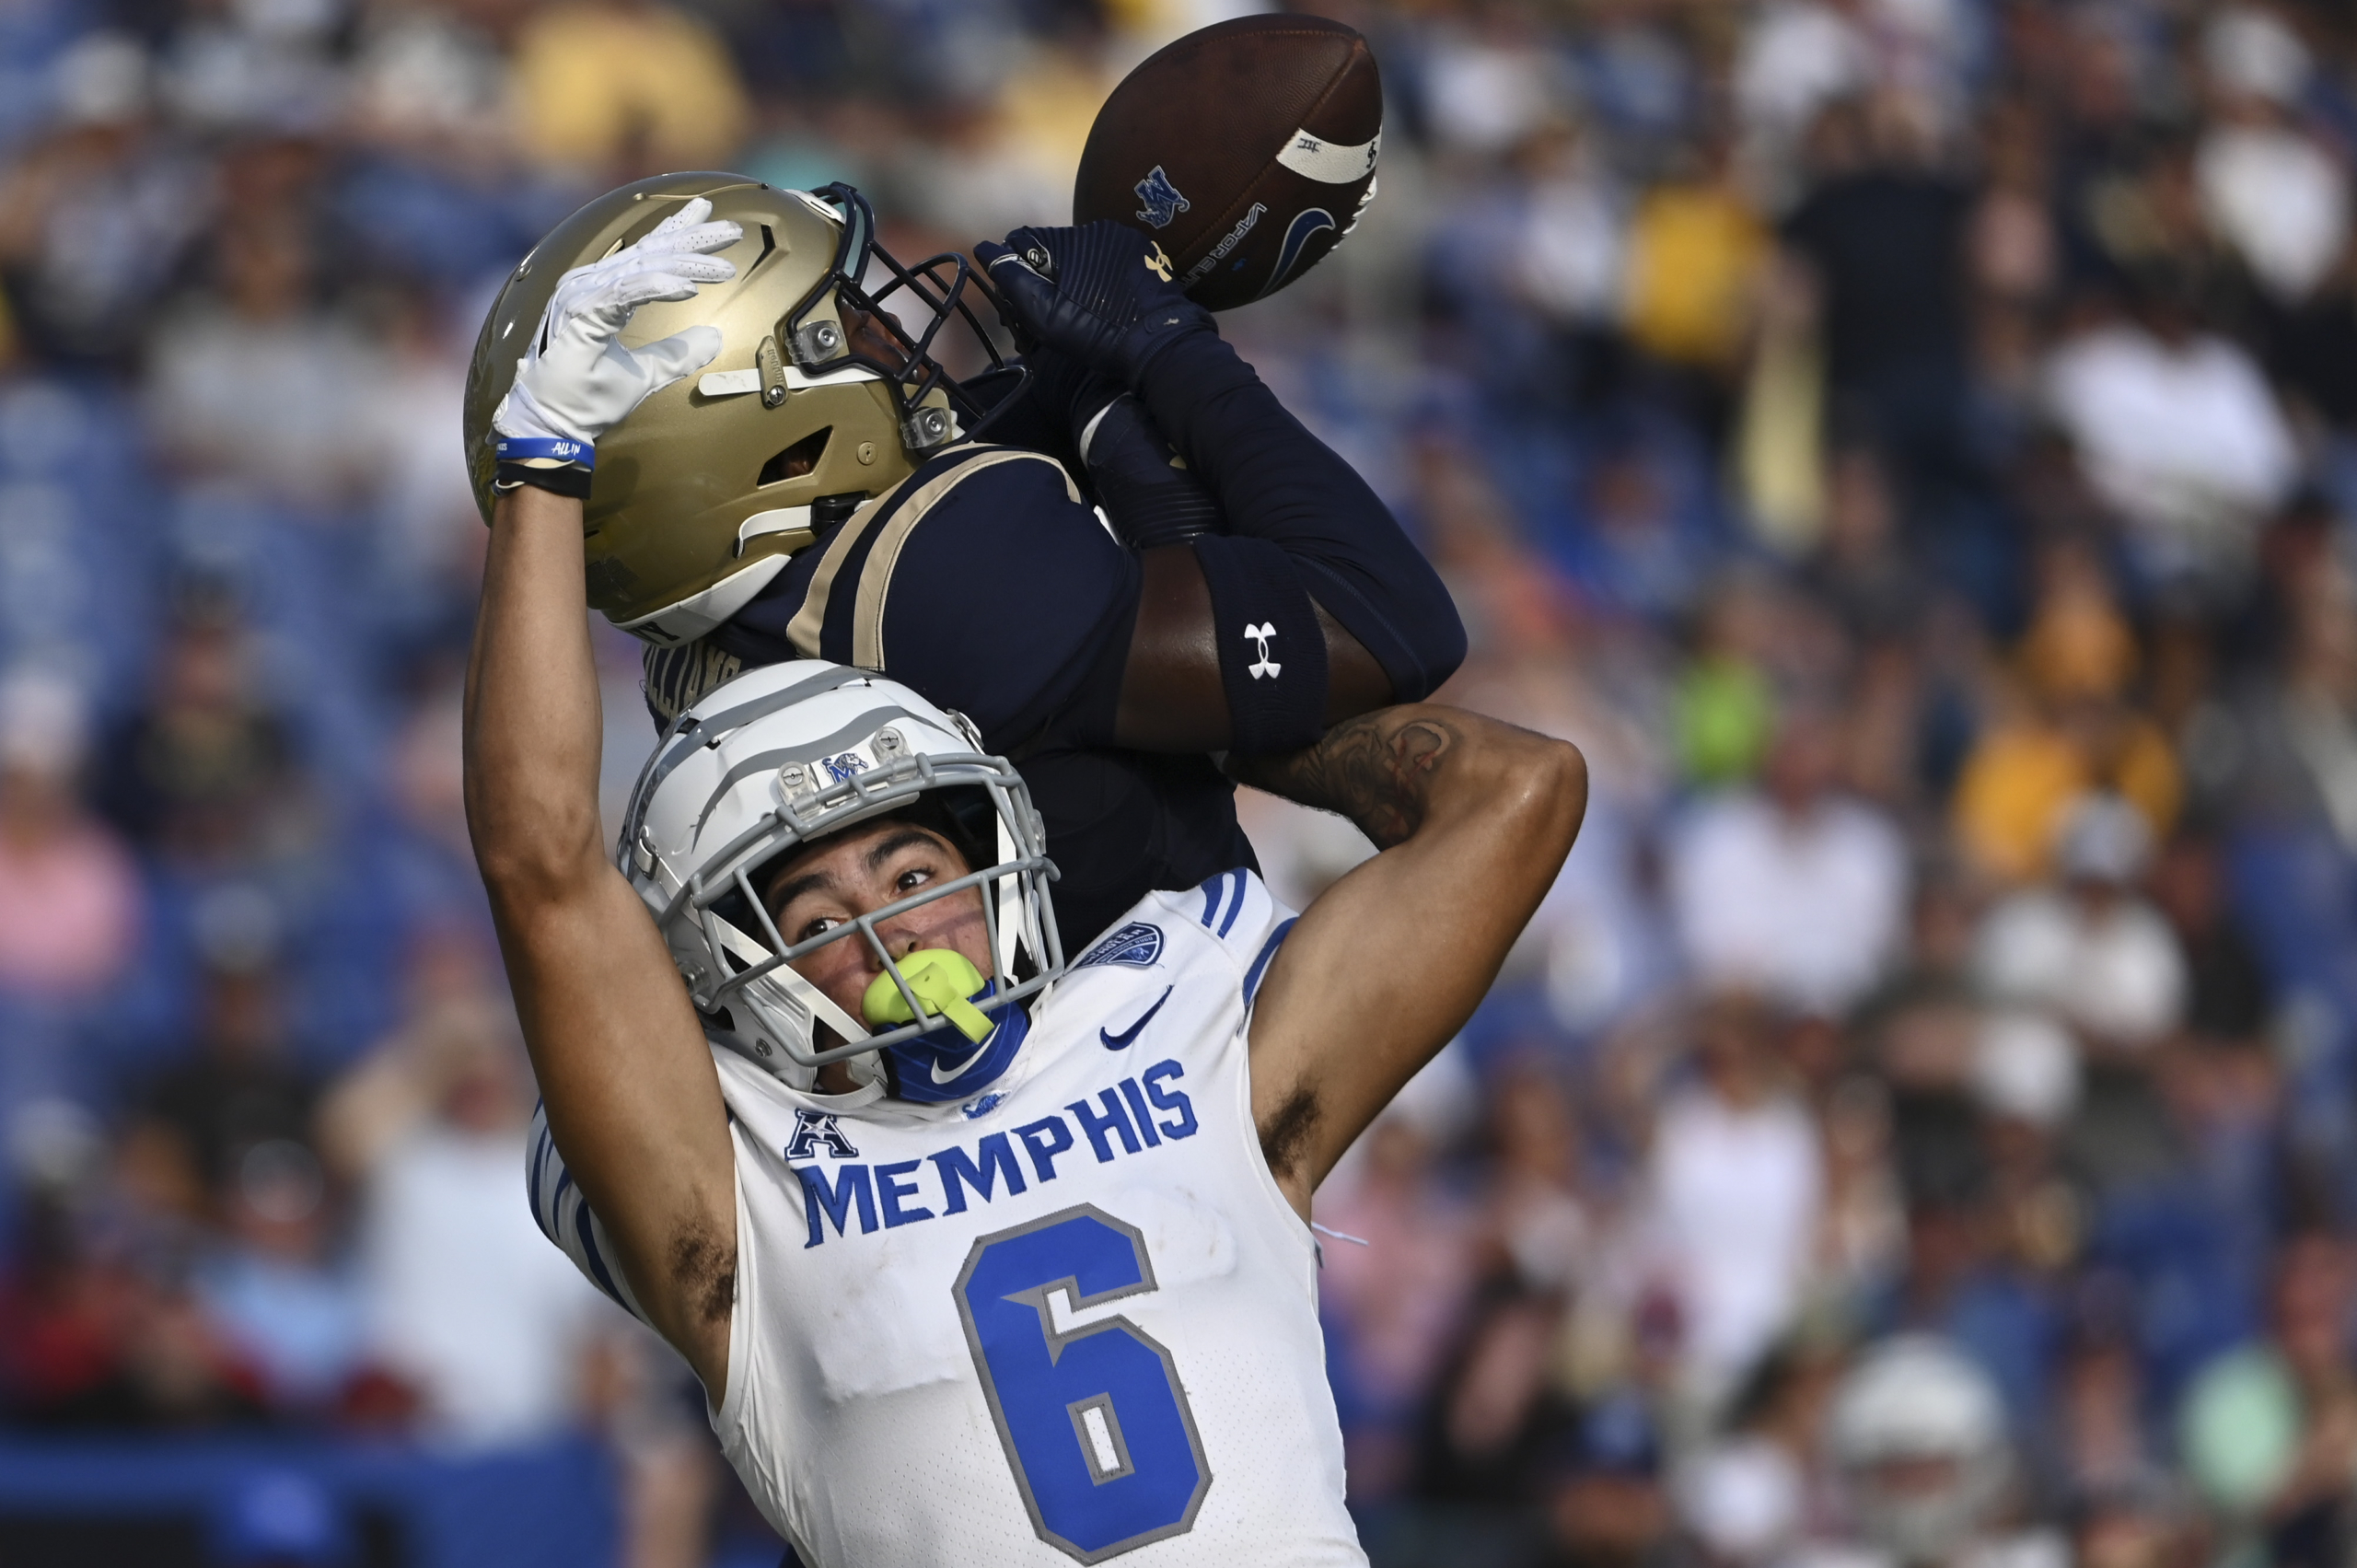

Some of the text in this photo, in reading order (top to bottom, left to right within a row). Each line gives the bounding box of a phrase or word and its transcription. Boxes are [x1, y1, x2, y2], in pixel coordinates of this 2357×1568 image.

[1178, 202, 1268, 288] VAPOR ELIT
[551, 441, 582, 457] ALL IN
[790, 1058, 1199, 1249] MEMPHIS
[951, 1202, 1214, 1567] 6
